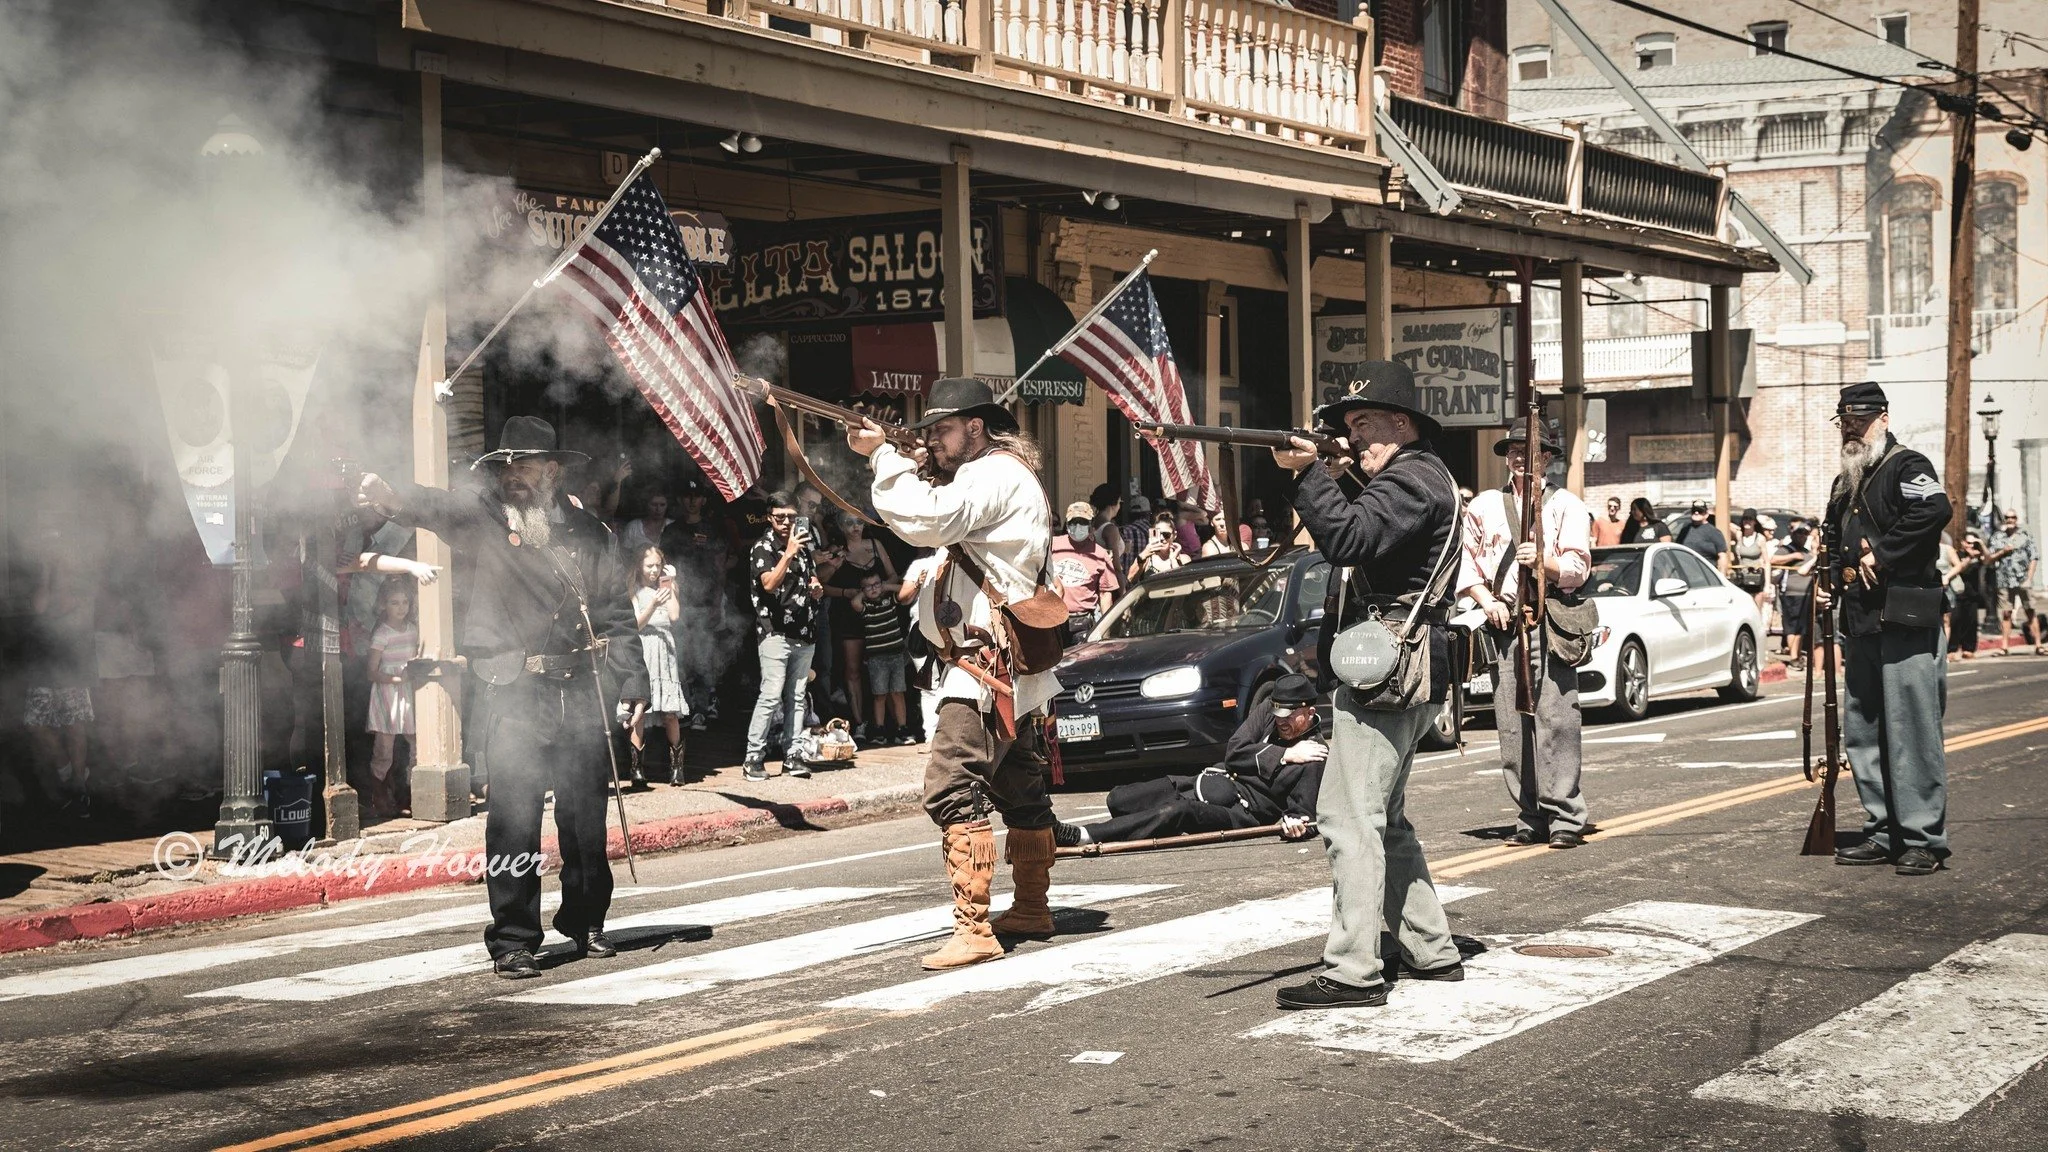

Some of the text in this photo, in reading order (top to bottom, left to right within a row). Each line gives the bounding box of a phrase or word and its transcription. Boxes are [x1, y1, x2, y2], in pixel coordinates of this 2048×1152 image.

[612, 154, 622, 174] D
[556, 196, 607, 211] FAMO
[487, 193, 545, 238] See the
[528, 210, 729, 265] SUIC BLE
[704, 227, 984, 310] ELTA SALON
[876, 289, 945, 311] 187
[790, 332, 847, 345] CAPPUCCINO
[1426, 345, 1500, 378] CORNER
[871, 371, 922, 392] LATTE
[1023, 380, 1083, 397] ESPRESSO
[197, 455, 215, 463] AIR
[189, 466, 224, 475] FORCE
[1349, 631, 1379, 639] UNION
[1341, 656, 1379, 665] LIBERTY
[260, 825, 269, 840] 60
